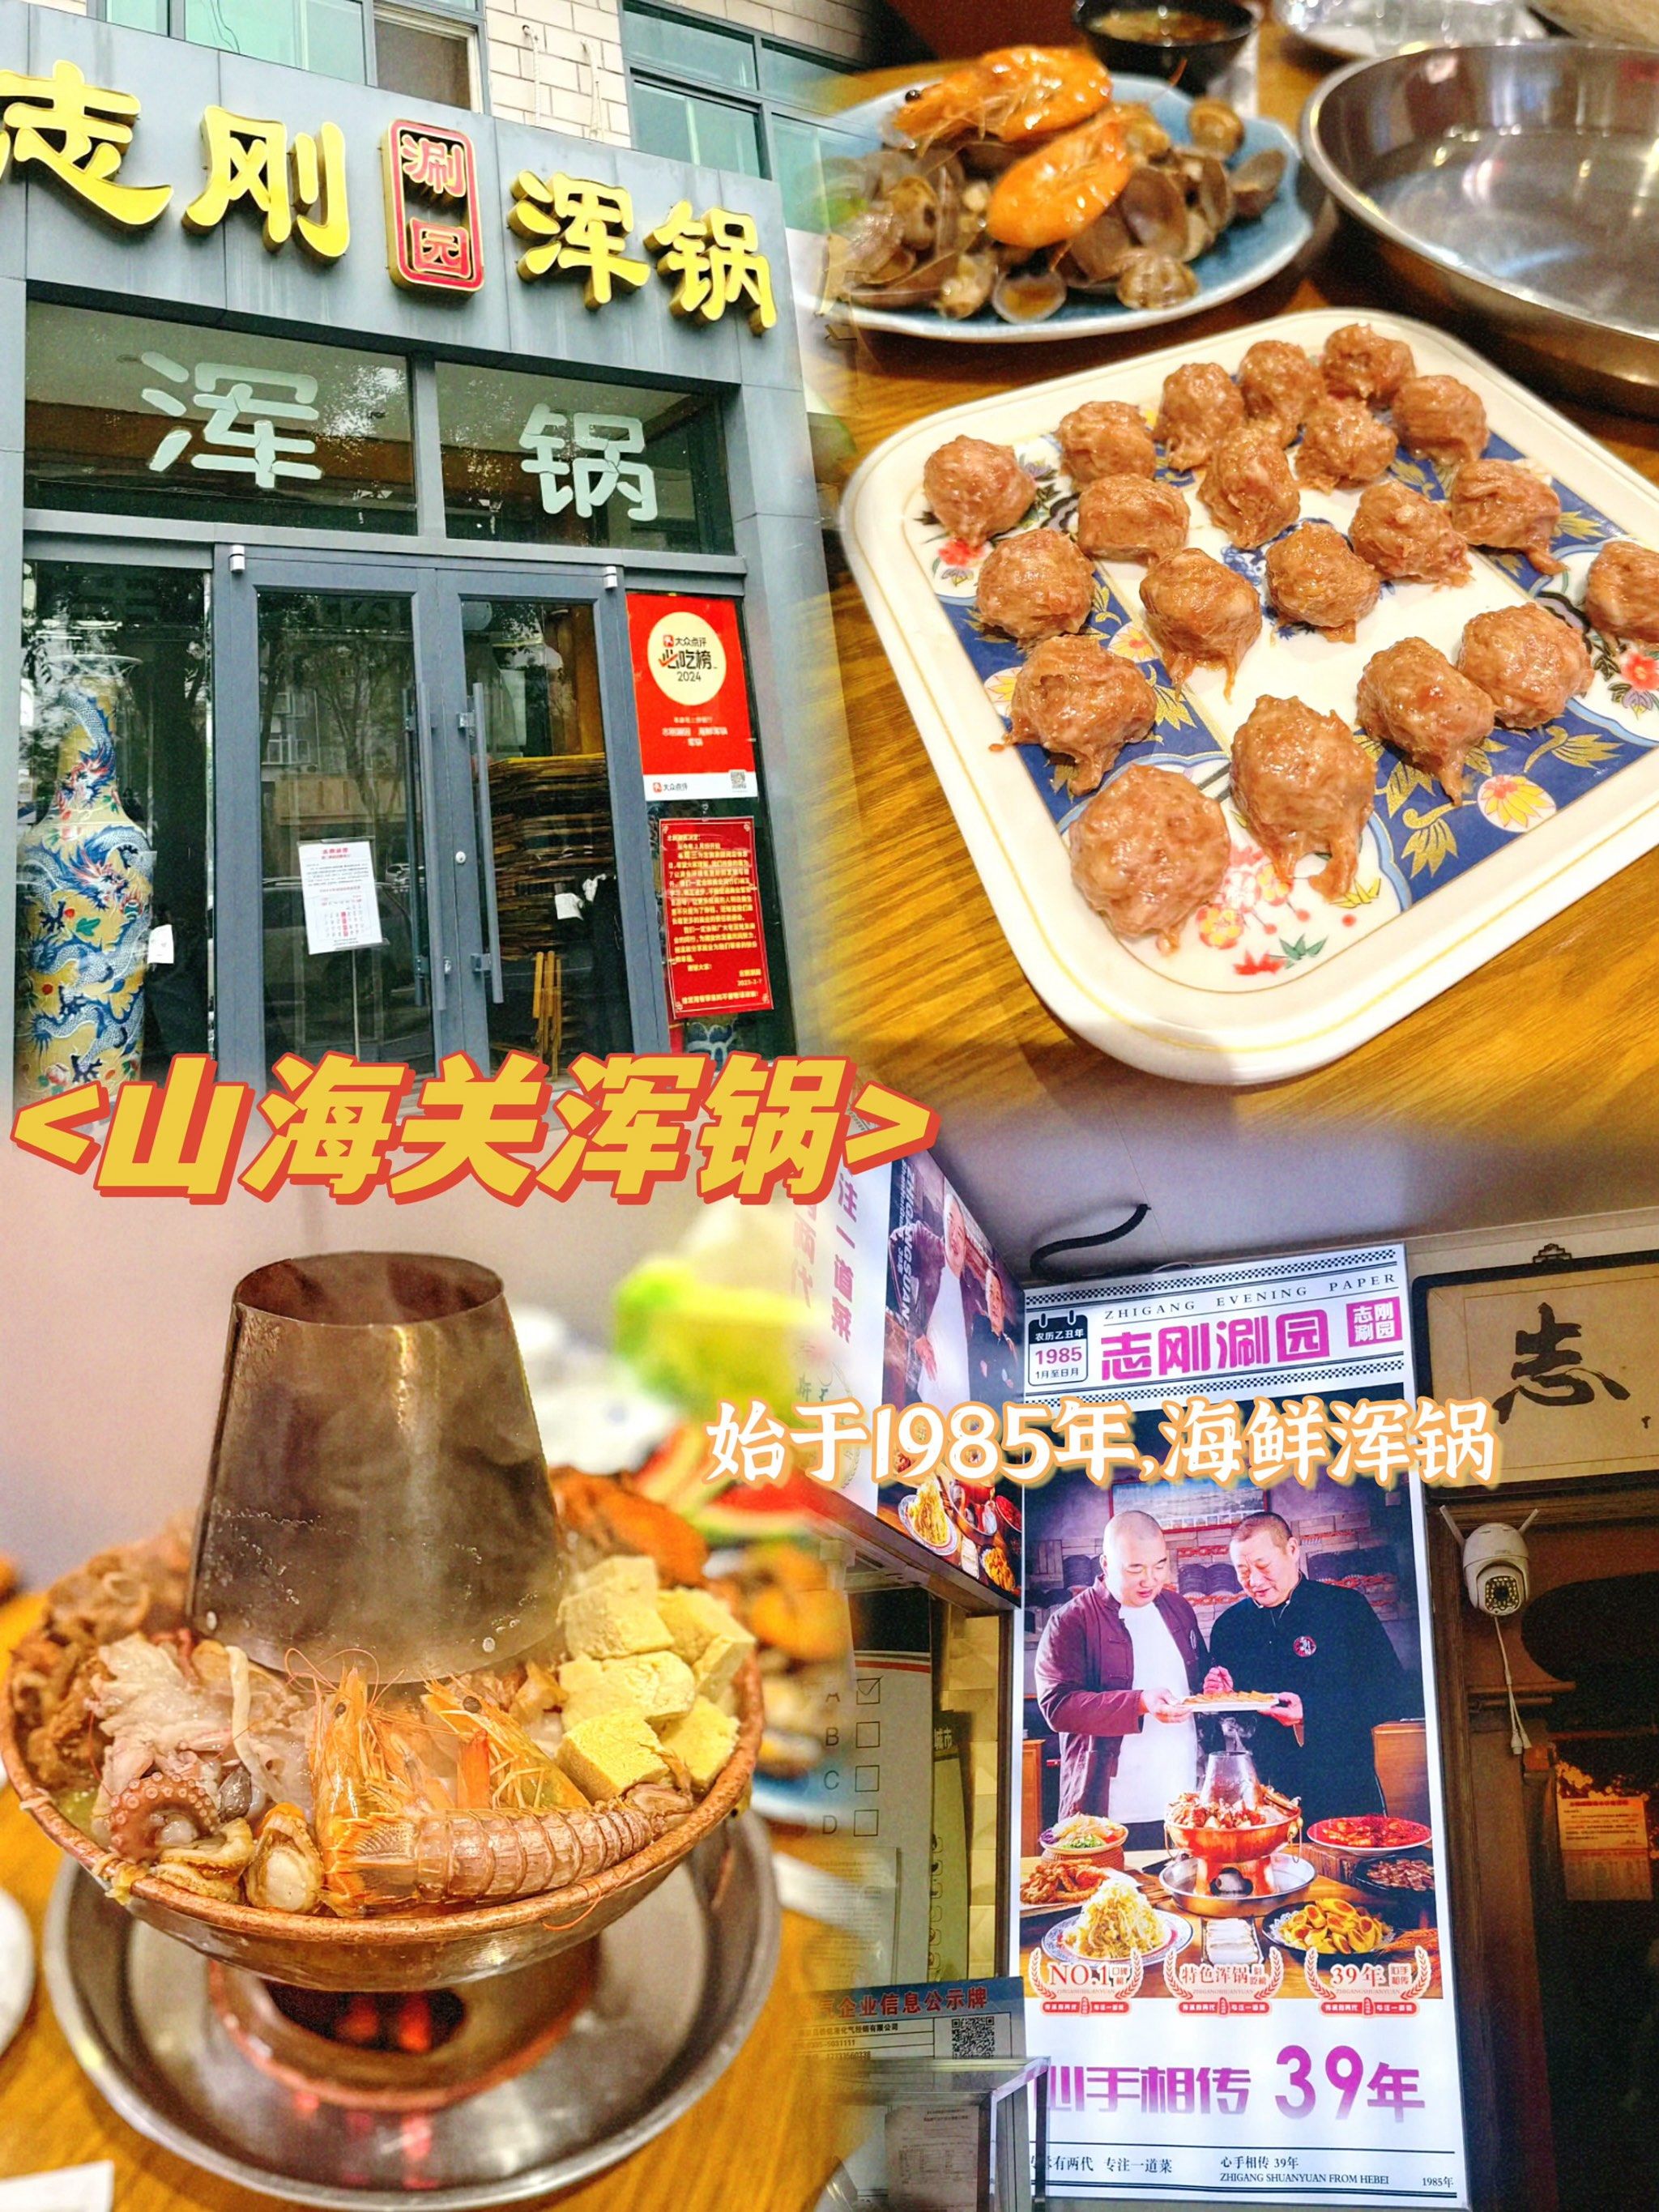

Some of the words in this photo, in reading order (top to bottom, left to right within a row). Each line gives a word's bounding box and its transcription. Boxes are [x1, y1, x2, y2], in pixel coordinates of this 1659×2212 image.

[0, 59, 350, 266] 志刚
[508, 169, 778, 337] 浑锅
[675, 637, 706, 647] 大众点评
[659, 649, 712, 670] 必吃榜
[676, 671, 702, 681] 2024
[1104, 1300, 1196, 1320] ZHIGANG
[1216, 1285, 1308, 1308] EVENING
[1329, 1273, 1397, 1293] PAPER
[1034, 1328, 1085, 1342] 农历乙丑年
[1101, 1308, 1330, 1381] 志刚涮园
[1034, 1346, 1083, 1366] 1985
[825, 1727, 840, 1747] B
[823, 1769, 840, 1791] C
[822, 1814, 838, 1835] D
[1049, 1964, 1109, 1985] NO.1
[1181, 1965, 1248, 1984] 特色浑锅
[1333, 1966, 1384, 1987] 39年
[1274, 2044, 1426, 2124] 39年
[1105, 2156, 1173, 2174] 专注一道菜
[1220, 2155, 1269, 2170] 心手相传
[1273, 2155, 1299, 2170] 39年
[1220, 2172, 1264, 2183] ZHIGANG
[1265, 2173, 1327, 2184] SHUANYUAN
[1328, 2174, 1358, 2184] FROM
[1359, 2175, 1389, 2185] HEBEI
[1422, 2176, 1454, 2189] 1985年
